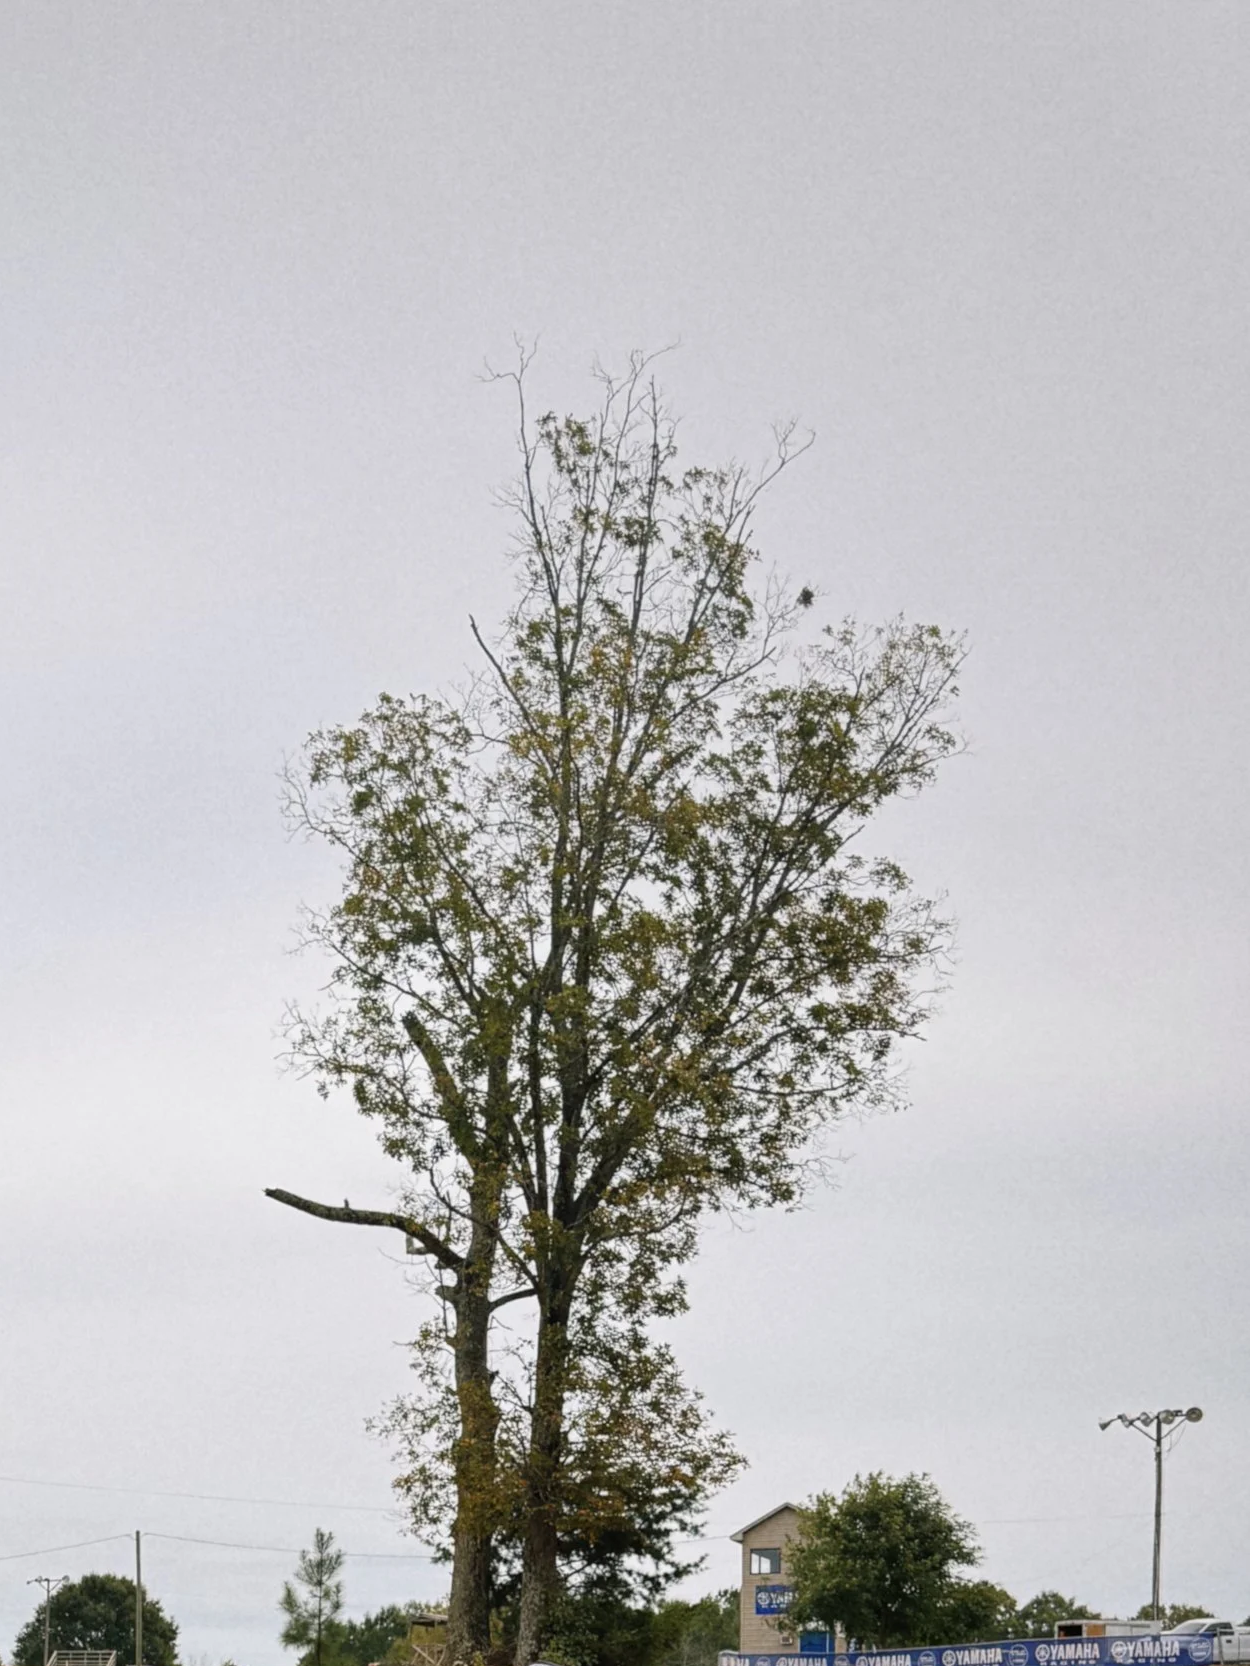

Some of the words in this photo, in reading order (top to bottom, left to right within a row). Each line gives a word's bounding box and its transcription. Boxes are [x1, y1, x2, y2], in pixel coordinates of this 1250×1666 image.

[956, 1648, 1003, 1665] YAMAHA
[1051, 1643, 1100, 1660] YAMAHA
[1127, 1641, 1180, 1658] YAMAHA
